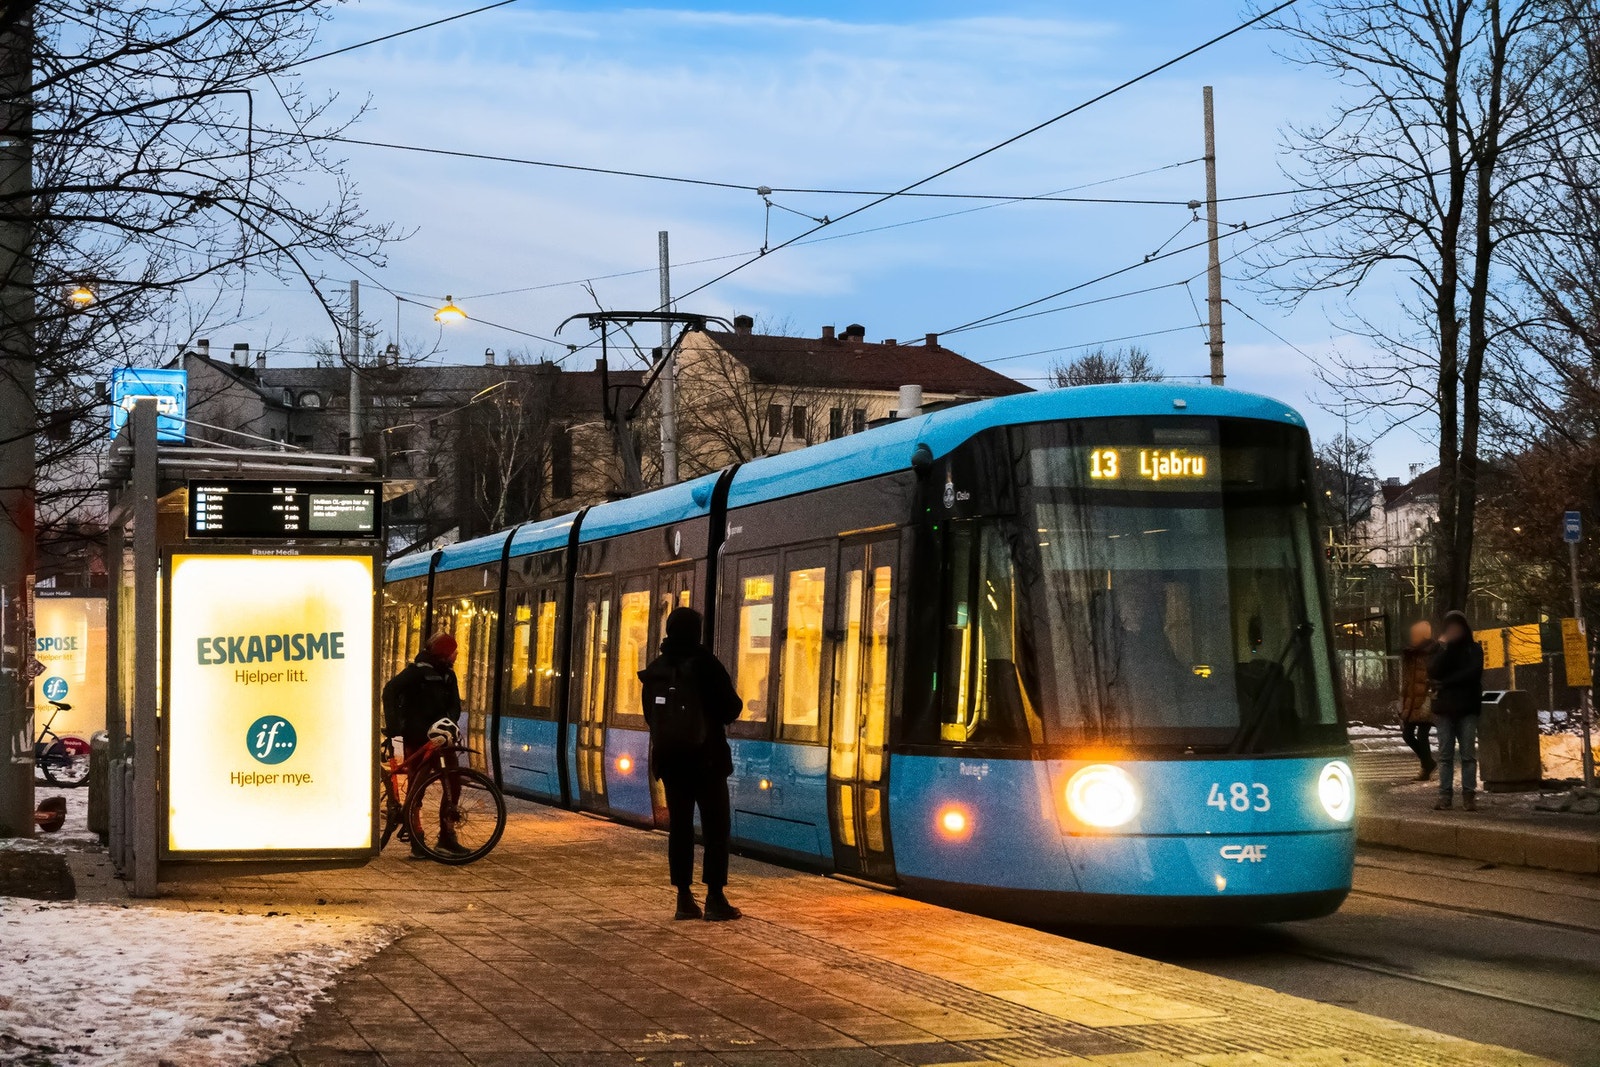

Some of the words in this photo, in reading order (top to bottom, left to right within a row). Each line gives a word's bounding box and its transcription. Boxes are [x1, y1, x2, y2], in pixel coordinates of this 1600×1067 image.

[1090, 450, 1119, 479] 13
[1140, 450, 1206, 481] Ljabru
[956, 491, 970, 501] Oslo
[197, 631, 345, 666] ESKAPISME
[38, 654, 62, 662] Hjelper
[235, 669, 284, 686] Hjelper
[286, 669, 308, 683] litt.
[230, 771, 279, 788] Hjelper
[282, 773, 314, 788] mye.
[1207, 782, 1272, 813] 483
[1220, 844, 1268, 863] CAF
